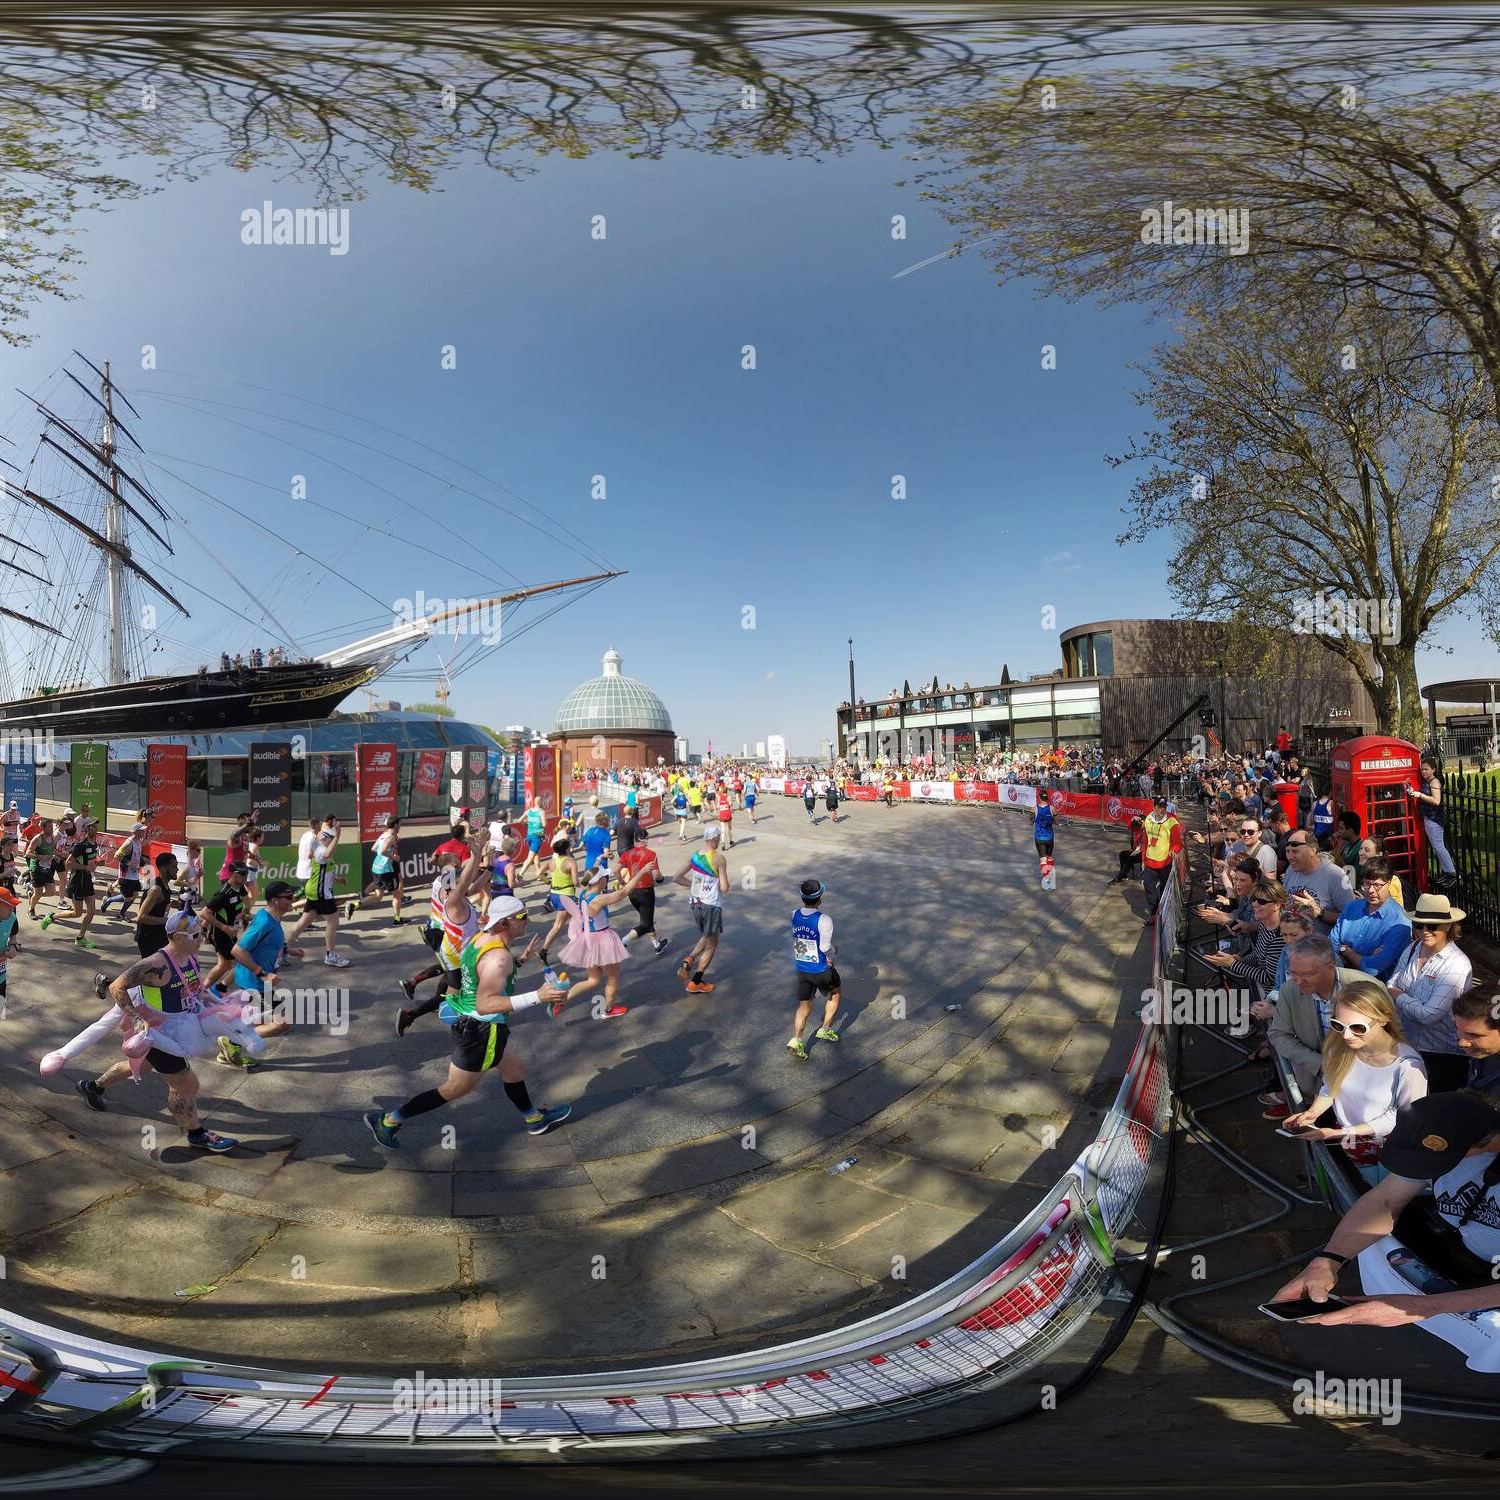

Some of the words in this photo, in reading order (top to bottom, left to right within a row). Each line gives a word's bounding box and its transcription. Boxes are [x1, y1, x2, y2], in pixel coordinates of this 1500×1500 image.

[1329, 707, 1351, 717] Zizzi
[253, 750, 280, 760] audible
[1364, 759, 1411, 769] TELEPHONE
[253, 775, 280, 784] audible
[253, 799, 280, 808] audible
[1439, 1201, 1465, 1216] 1966
